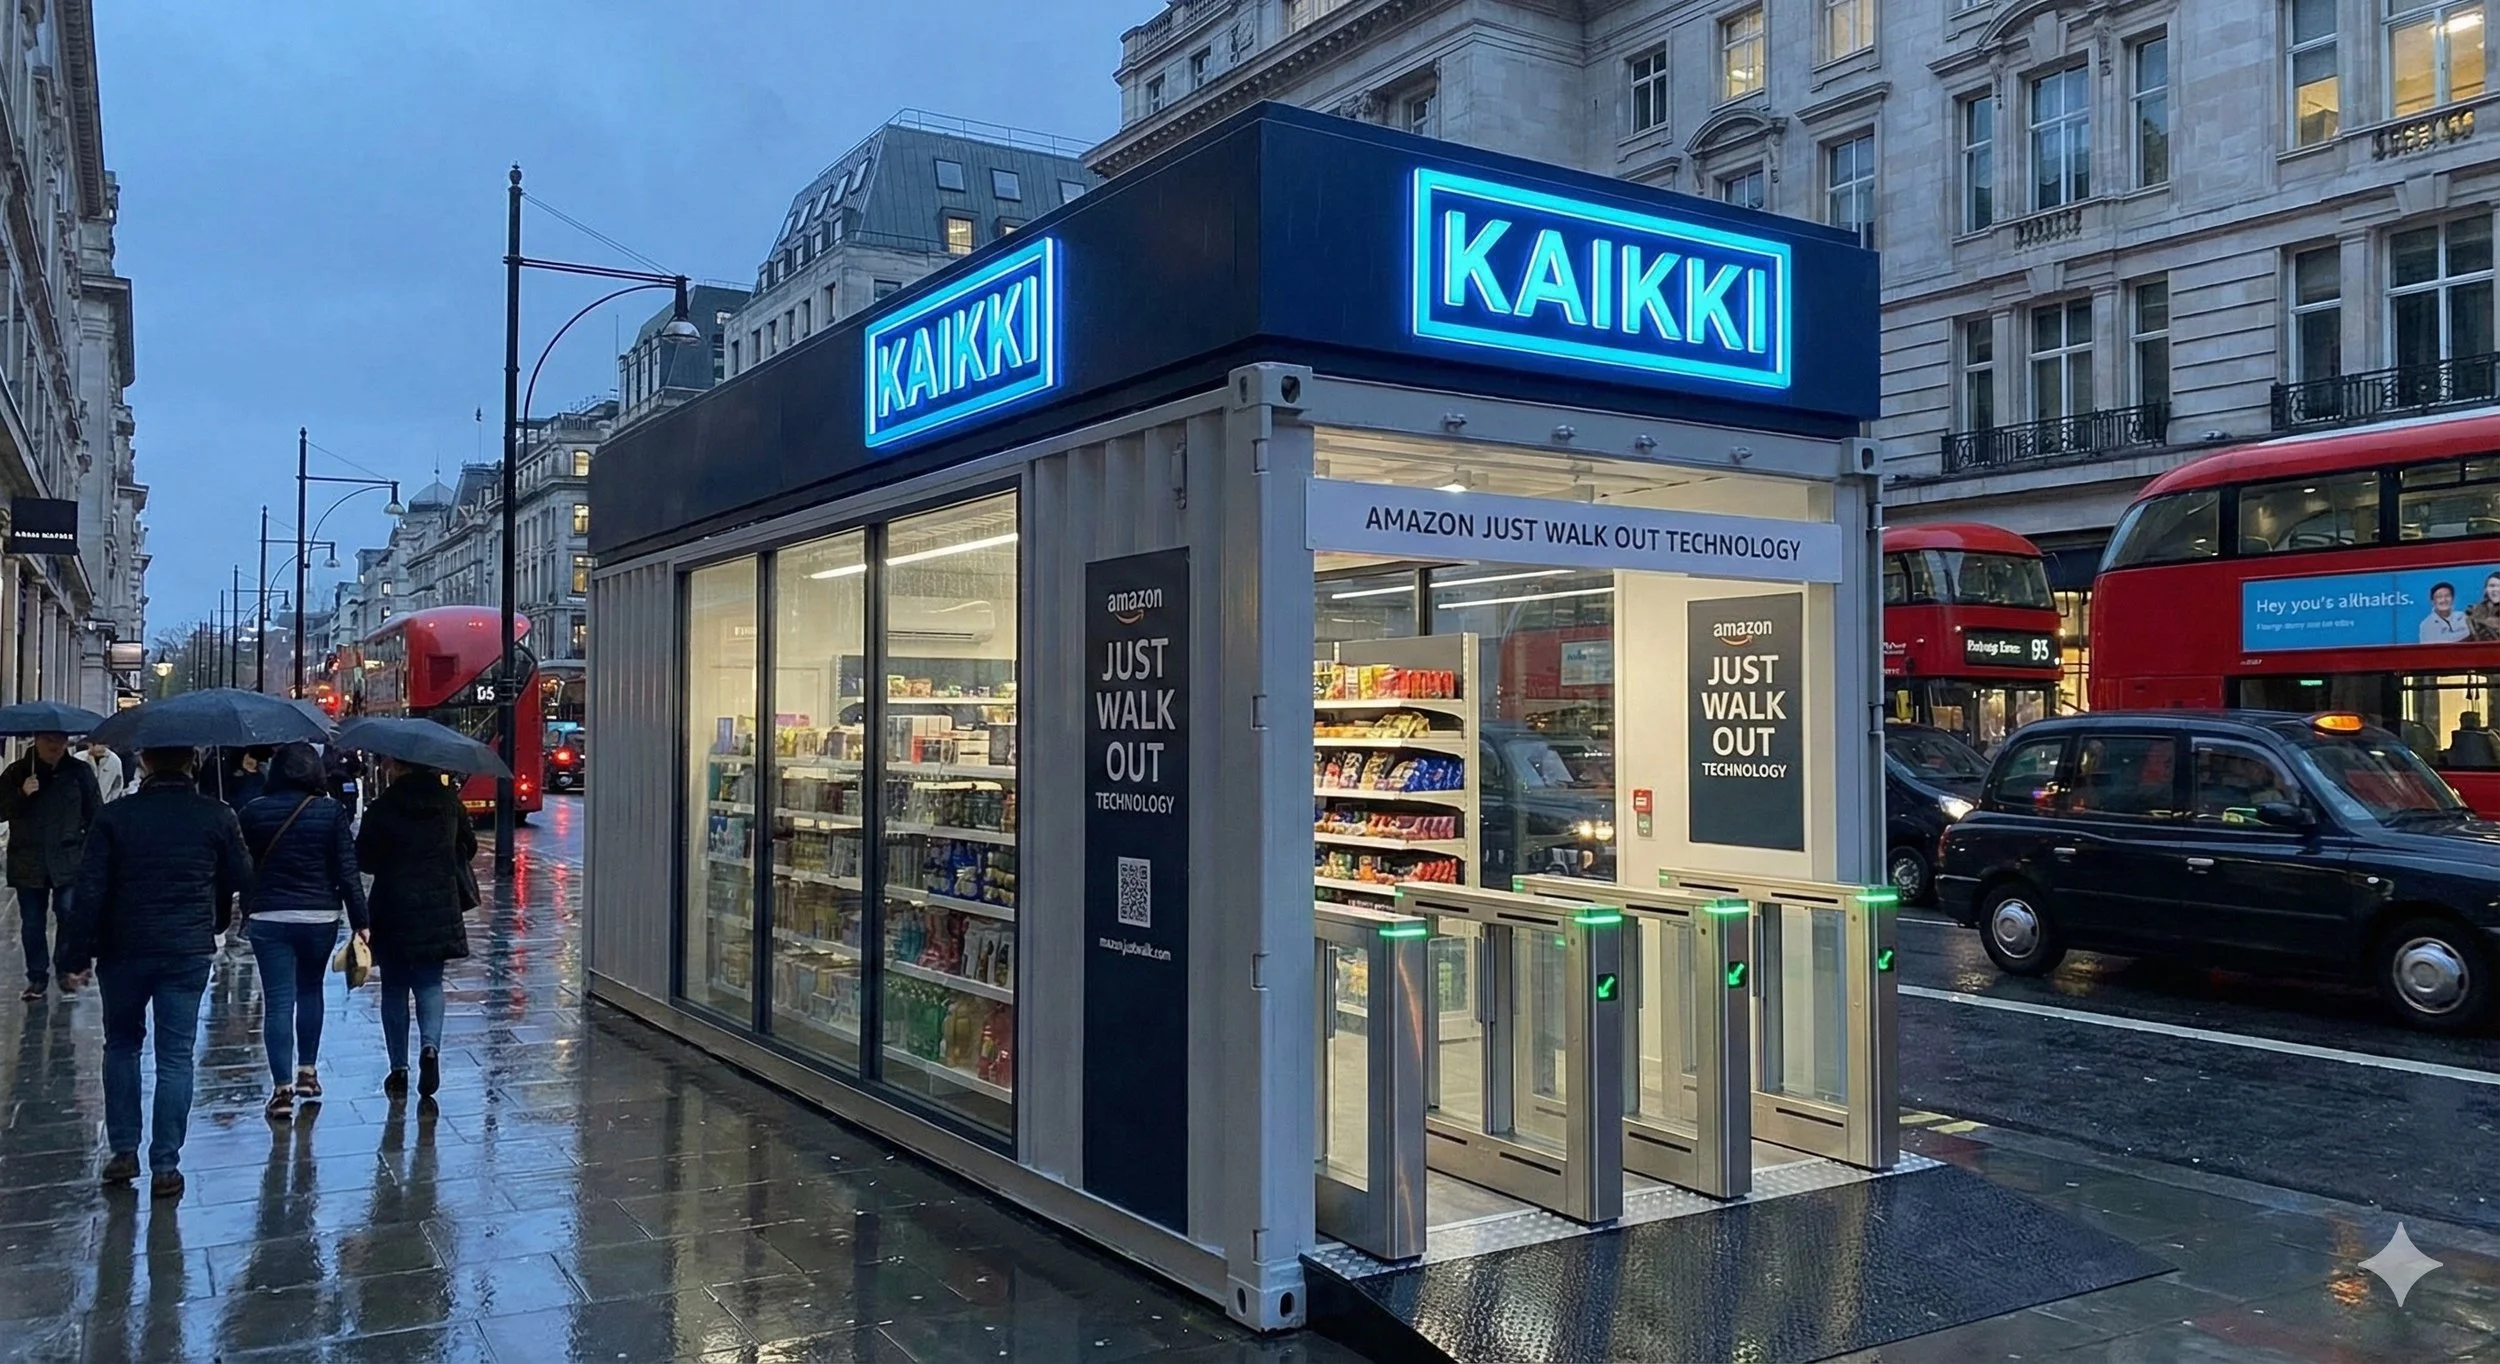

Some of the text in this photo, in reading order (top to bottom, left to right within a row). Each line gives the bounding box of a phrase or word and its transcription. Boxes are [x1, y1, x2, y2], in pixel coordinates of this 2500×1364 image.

[1443, 209, 1766, 354] KAIKKI
[877, 275, 1038, 418] KAIKKI
[1365, 506, 1801, 562] AMAZON JUST WALK OUT TECHNOLOGY
[1107, 588, 1163, 613] amazon
[2256, 599, 2288, 616] Hey
[1713, 620, 1773, 639] amazon
[1102, 637, 1169, 681] JUST
[1707, 654, 1779, 686] JUST
[1096, 688, 1176, 730] WALK
[1701, 690, 1787, 720] WALK
[1712, 726, 1776, 757] OUT
[1106, 741, 1165, 783] OUT
[1701, 762, 1787, 778] TECHNOLOGY
[1095, 791, 1175, 814] TECHNOLOGY
